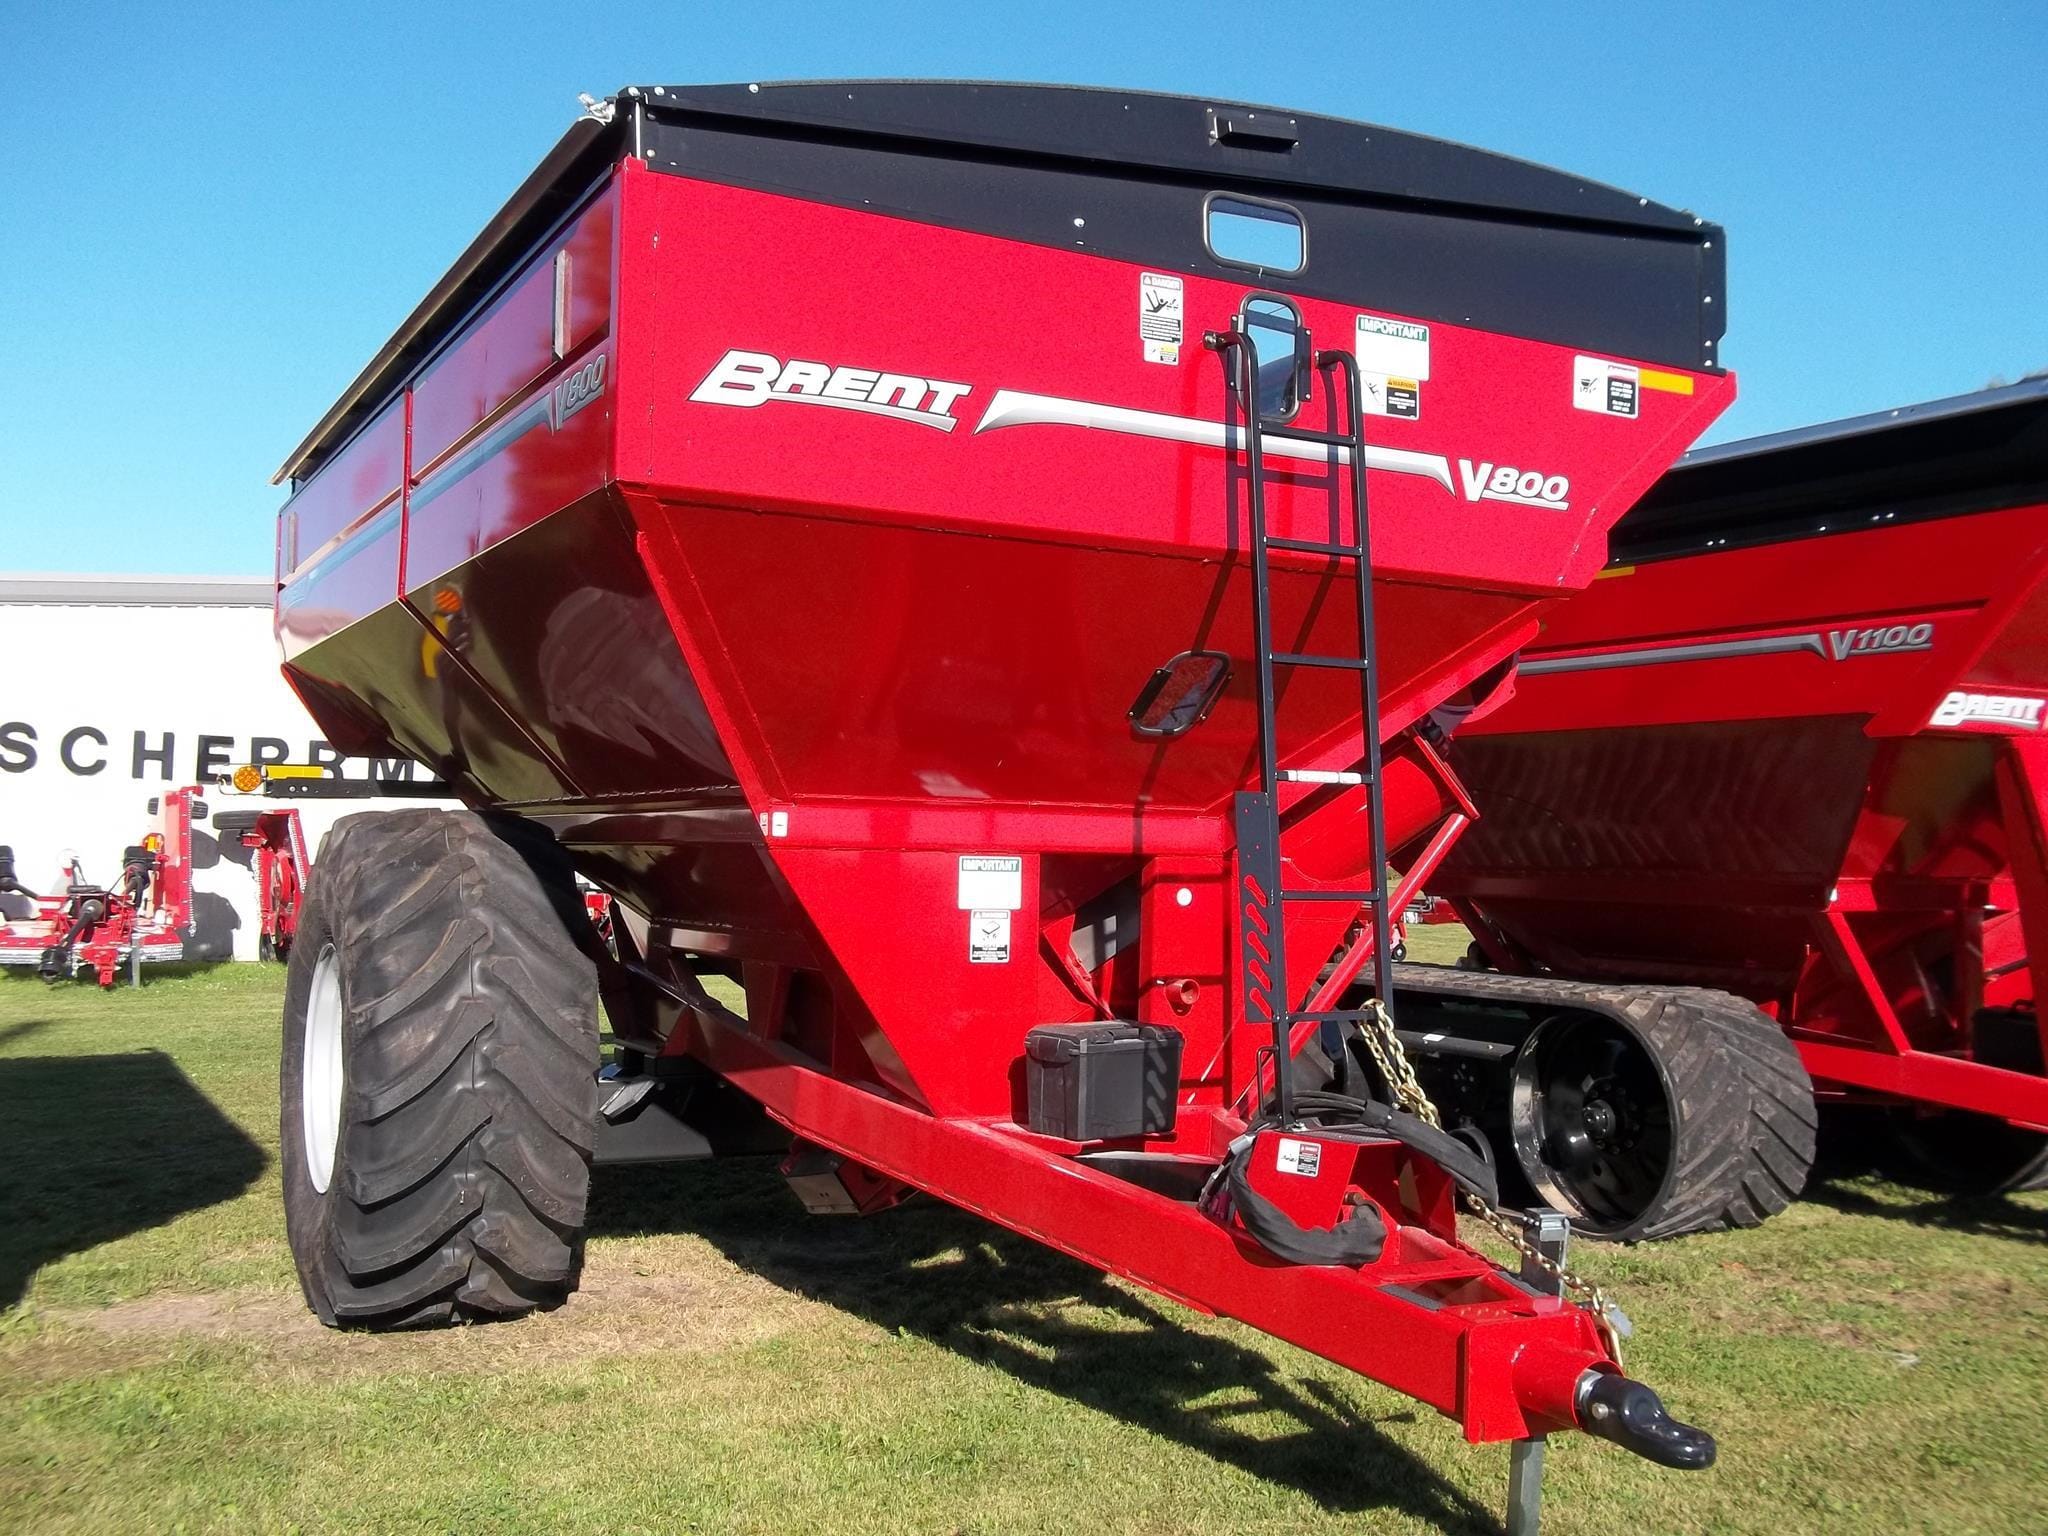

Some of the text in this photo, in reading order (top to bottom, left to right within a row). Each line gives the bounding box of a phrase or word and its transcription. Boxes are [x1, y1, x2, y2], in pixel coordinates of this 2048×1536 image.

[1360, 318, 1425, 341] IMPORTANT
[554, 354, 606, 430] V800
[1458, 457, 1570, 504] V800
[1830, 623, 1933, 661] V1100
[962, 859, 1018, 872] IMPORTANT
